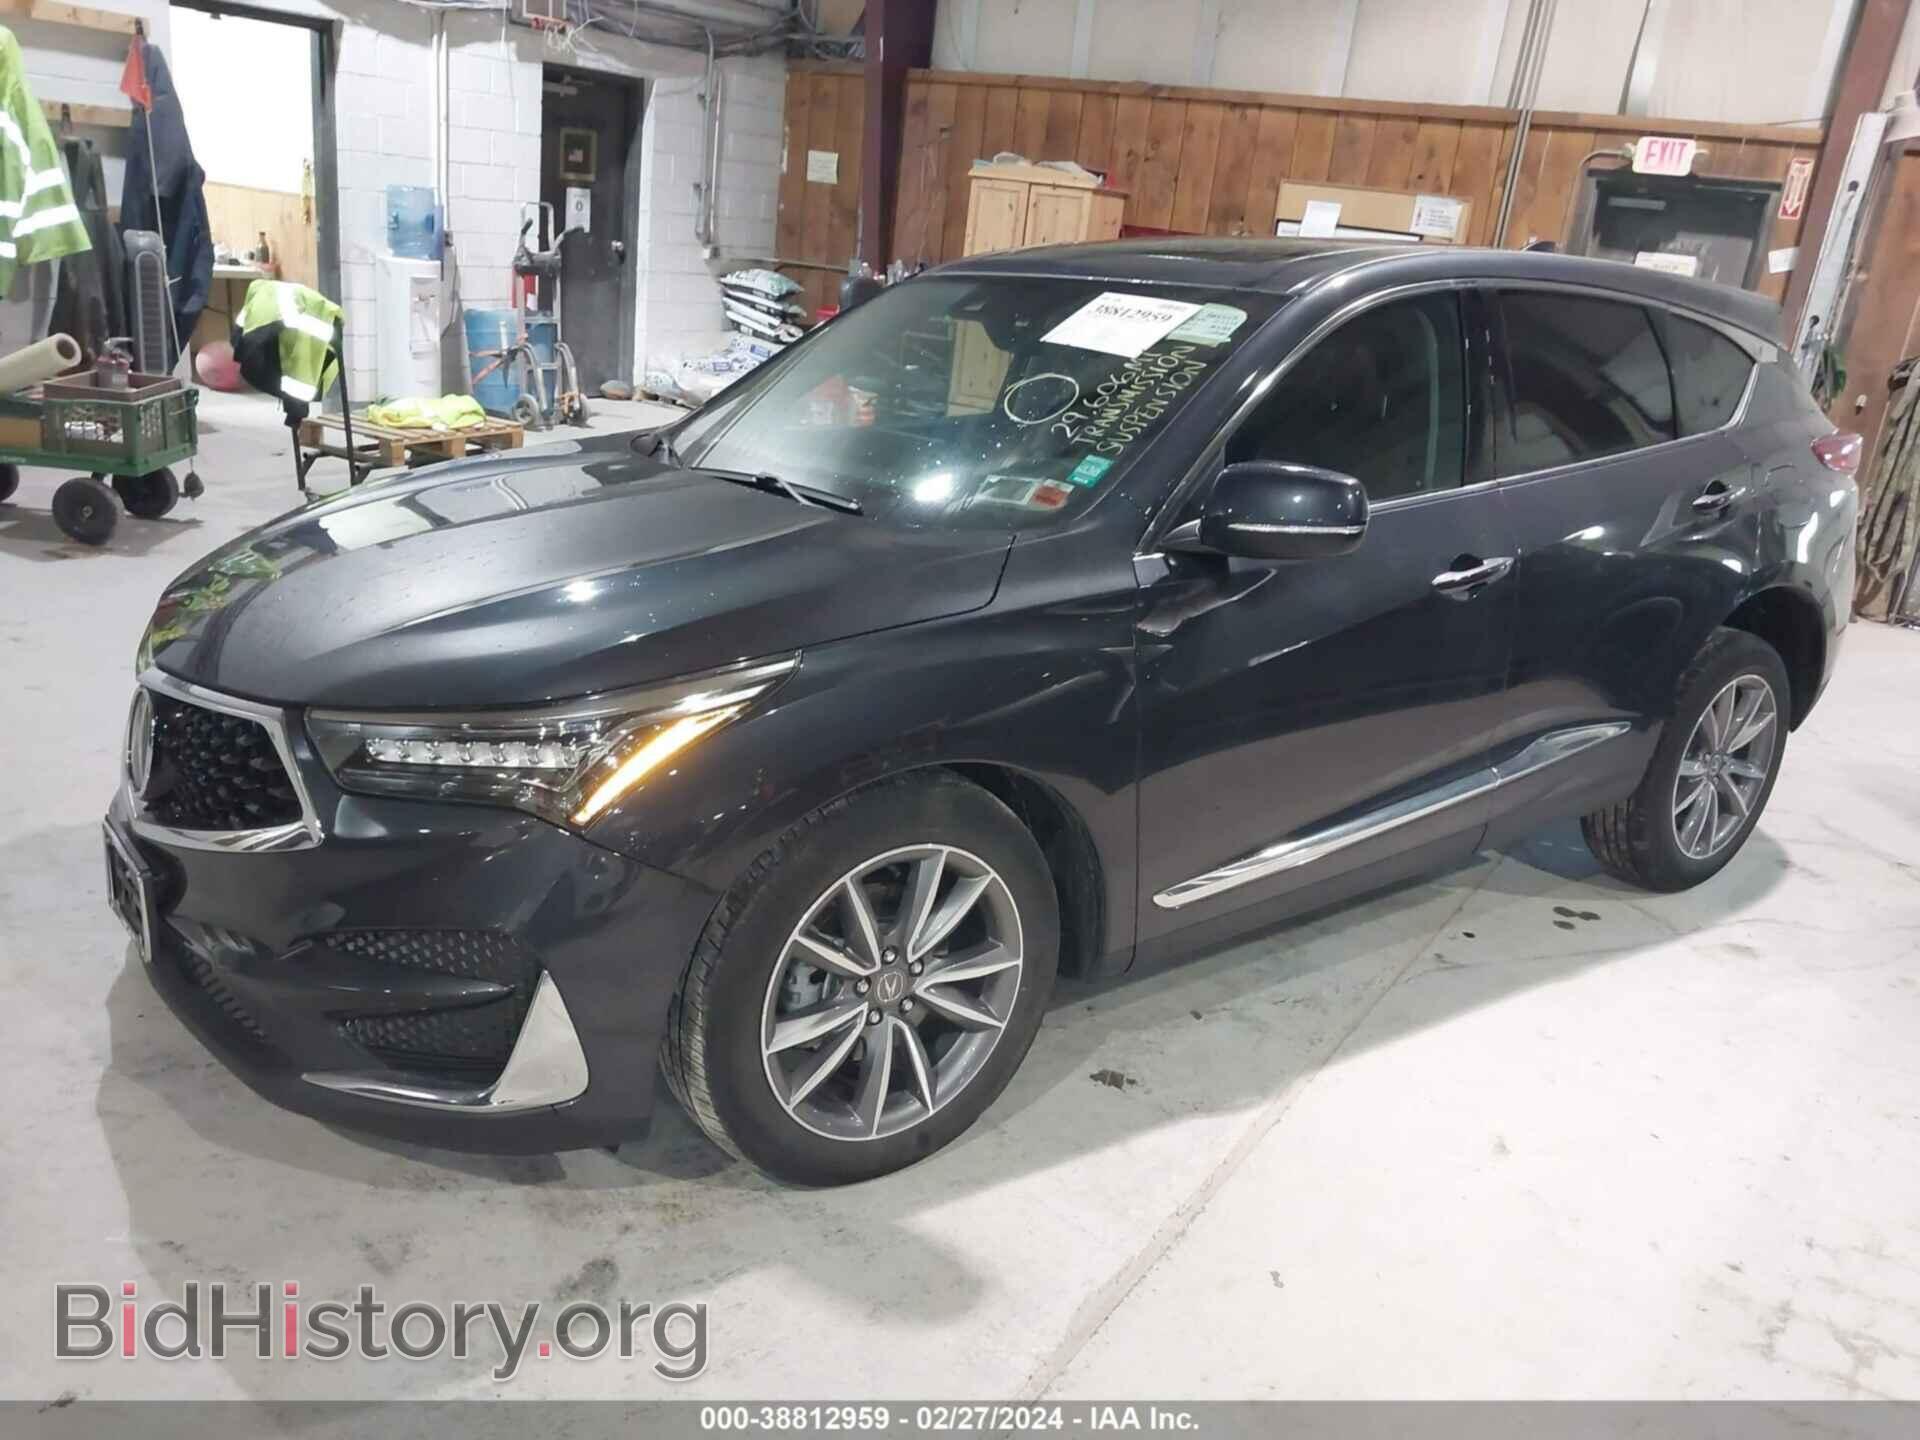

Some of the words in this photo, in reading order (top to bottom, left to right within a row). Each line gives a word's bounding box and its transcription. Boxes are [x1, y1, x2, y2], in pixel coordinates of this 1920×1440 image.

[1644, 140, 1688, 166] EXIT
[1070, 345, 1196, 444] TRANSMISSION
[1096, 359, 1208, 456] SUSPENSION
